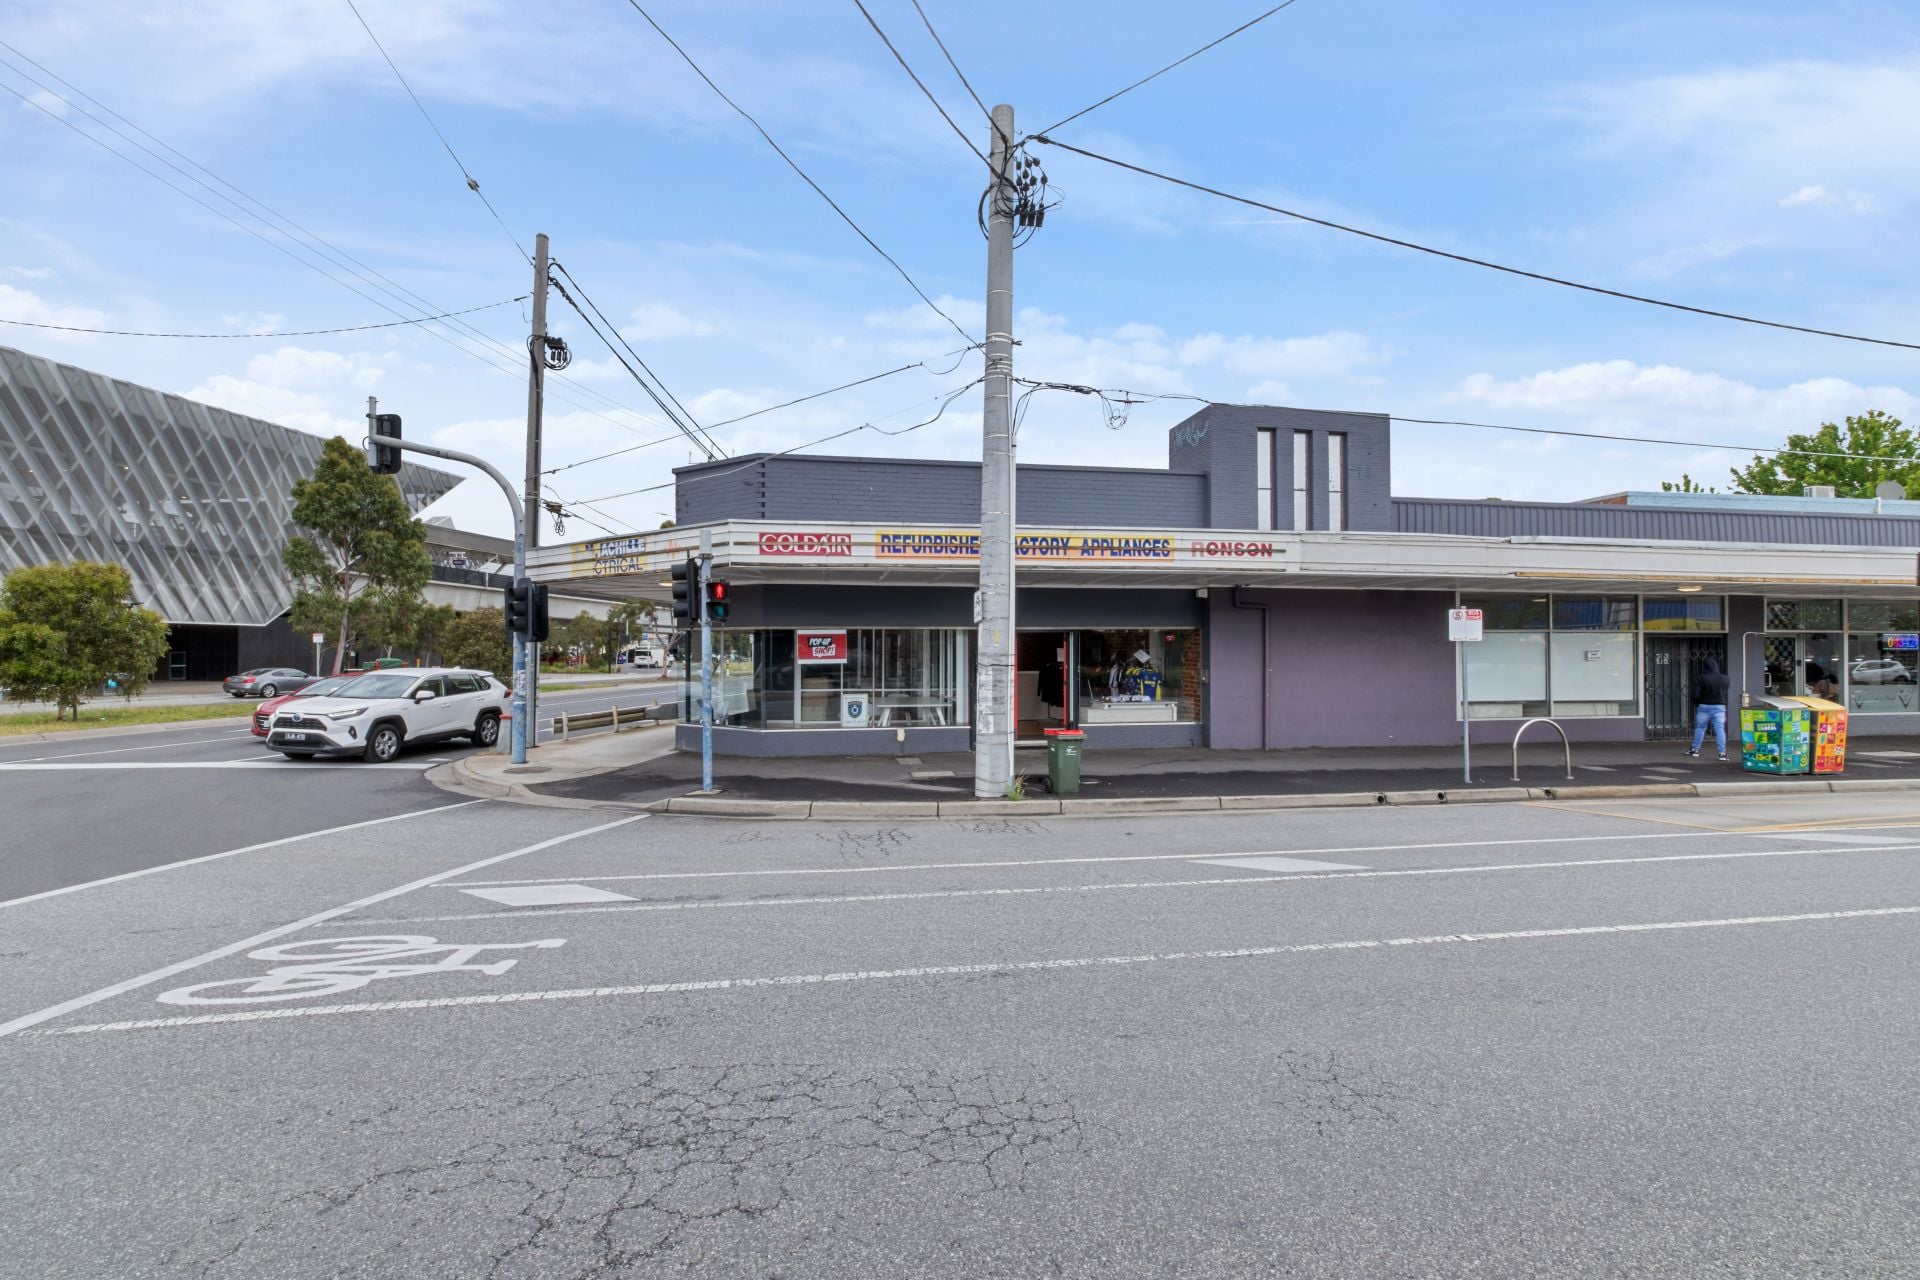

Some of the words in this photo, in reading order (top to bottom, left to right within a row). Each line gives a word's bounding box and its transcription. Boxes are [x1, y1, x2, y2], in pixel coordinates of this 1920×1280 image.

[761, 533, 850, 555] GOLDAIR
[880, 534, 980, 555] REFURBISHE
[1015, 536, 1070, 556] ACTORY
[1080, 538, 1170, 558] APPLIANCES
[1192, 541, 1273, 558] RONSON
[809, 637, 832, 646] POP-UP
[814, 646, 835, 655] SHOP!
